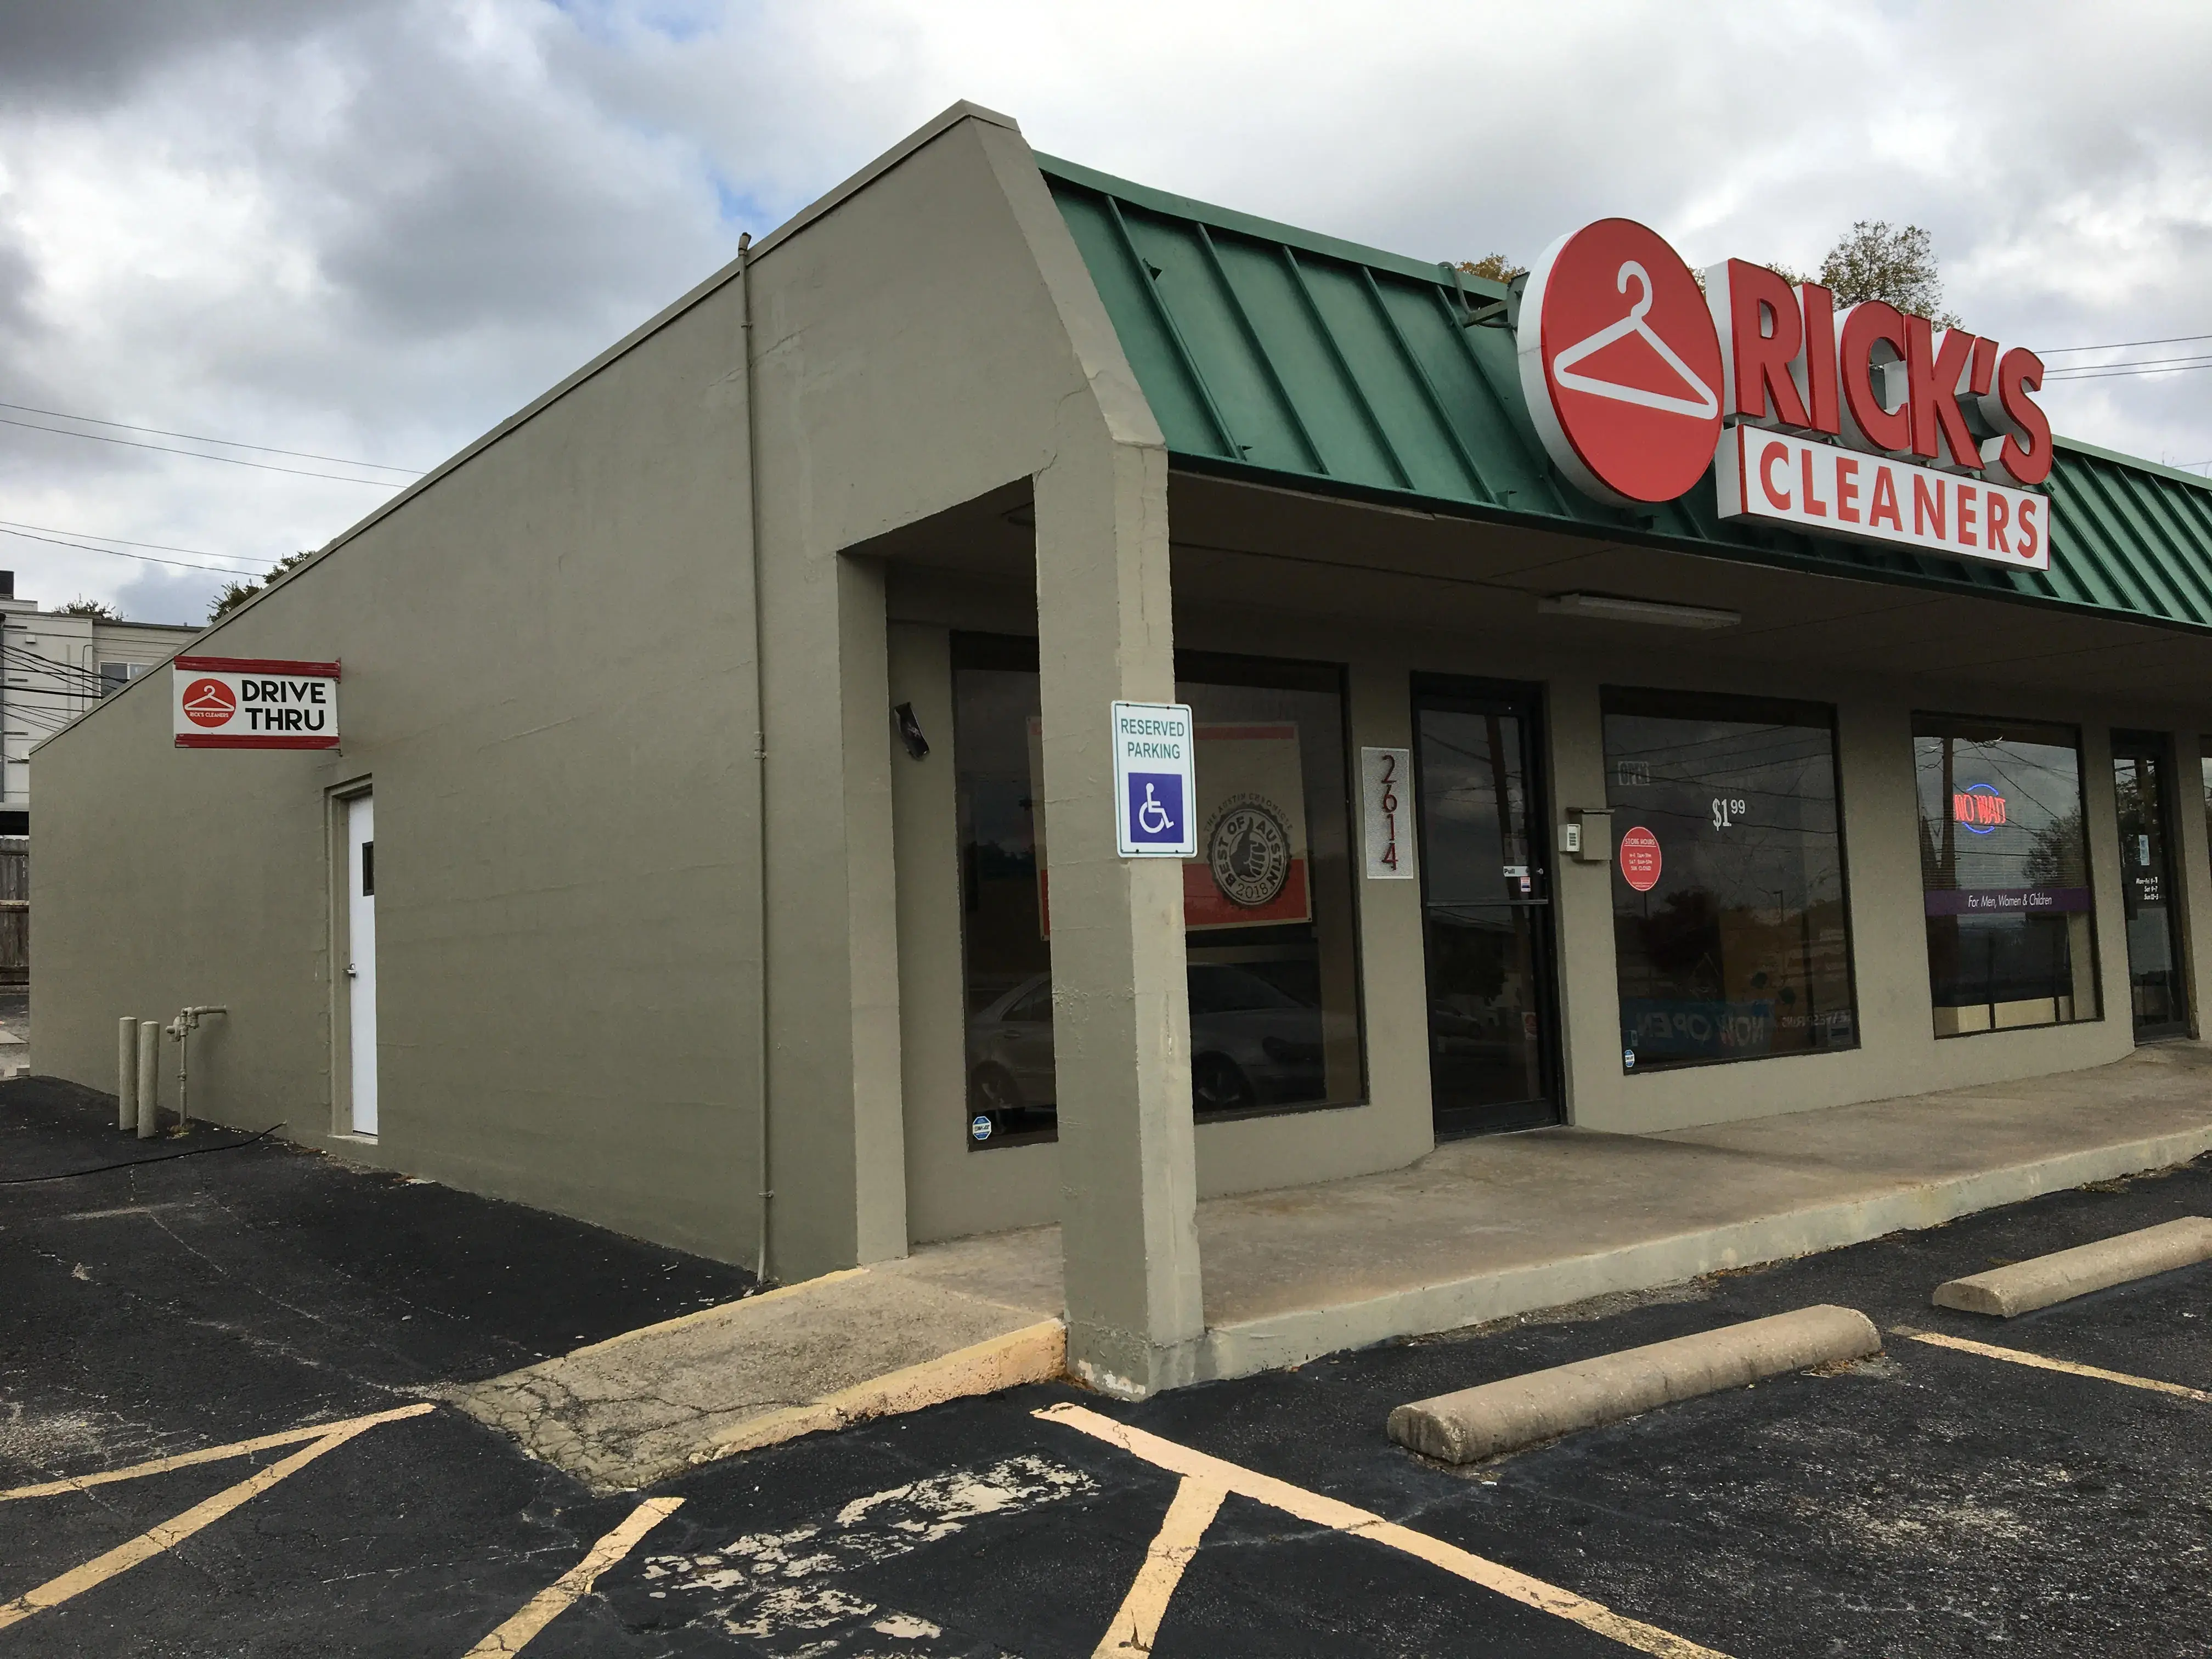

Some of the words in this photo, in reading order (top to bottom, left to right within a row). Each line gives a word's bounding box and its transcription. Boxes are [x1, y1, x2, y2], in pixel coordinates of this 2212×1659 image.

[1728, 257, 2053, 484] RICK'S
[1759, 441, 2038, 558] CLEANERS
[241, 679, 326, 704] DRIVE
[245, 707, 325, 731] THRU
[1121, 718, 1184, 737] RESERVED
[1127, 741, 1180, 759] PARKING
[1217, 792, 1246, 814] AUSTIN
[1381, 754, 1399, 871] 2614
[1953, 794, 1974, 822] NO
[1217, 837, 1237, 887] BEST
[1227, 815, 1245, 835] OF
[1256, 820, 1284, 888] AUSTIN
[1236, 882, 1268, 899] 2018
[1968, 895, 1979, 907] For
[1980, 895, 1996, 909] Men,
[1998, 894, 2021, 906] Women
[2023, 894, 2027, 906] &
[2029, 892, 2052, 906] Children
